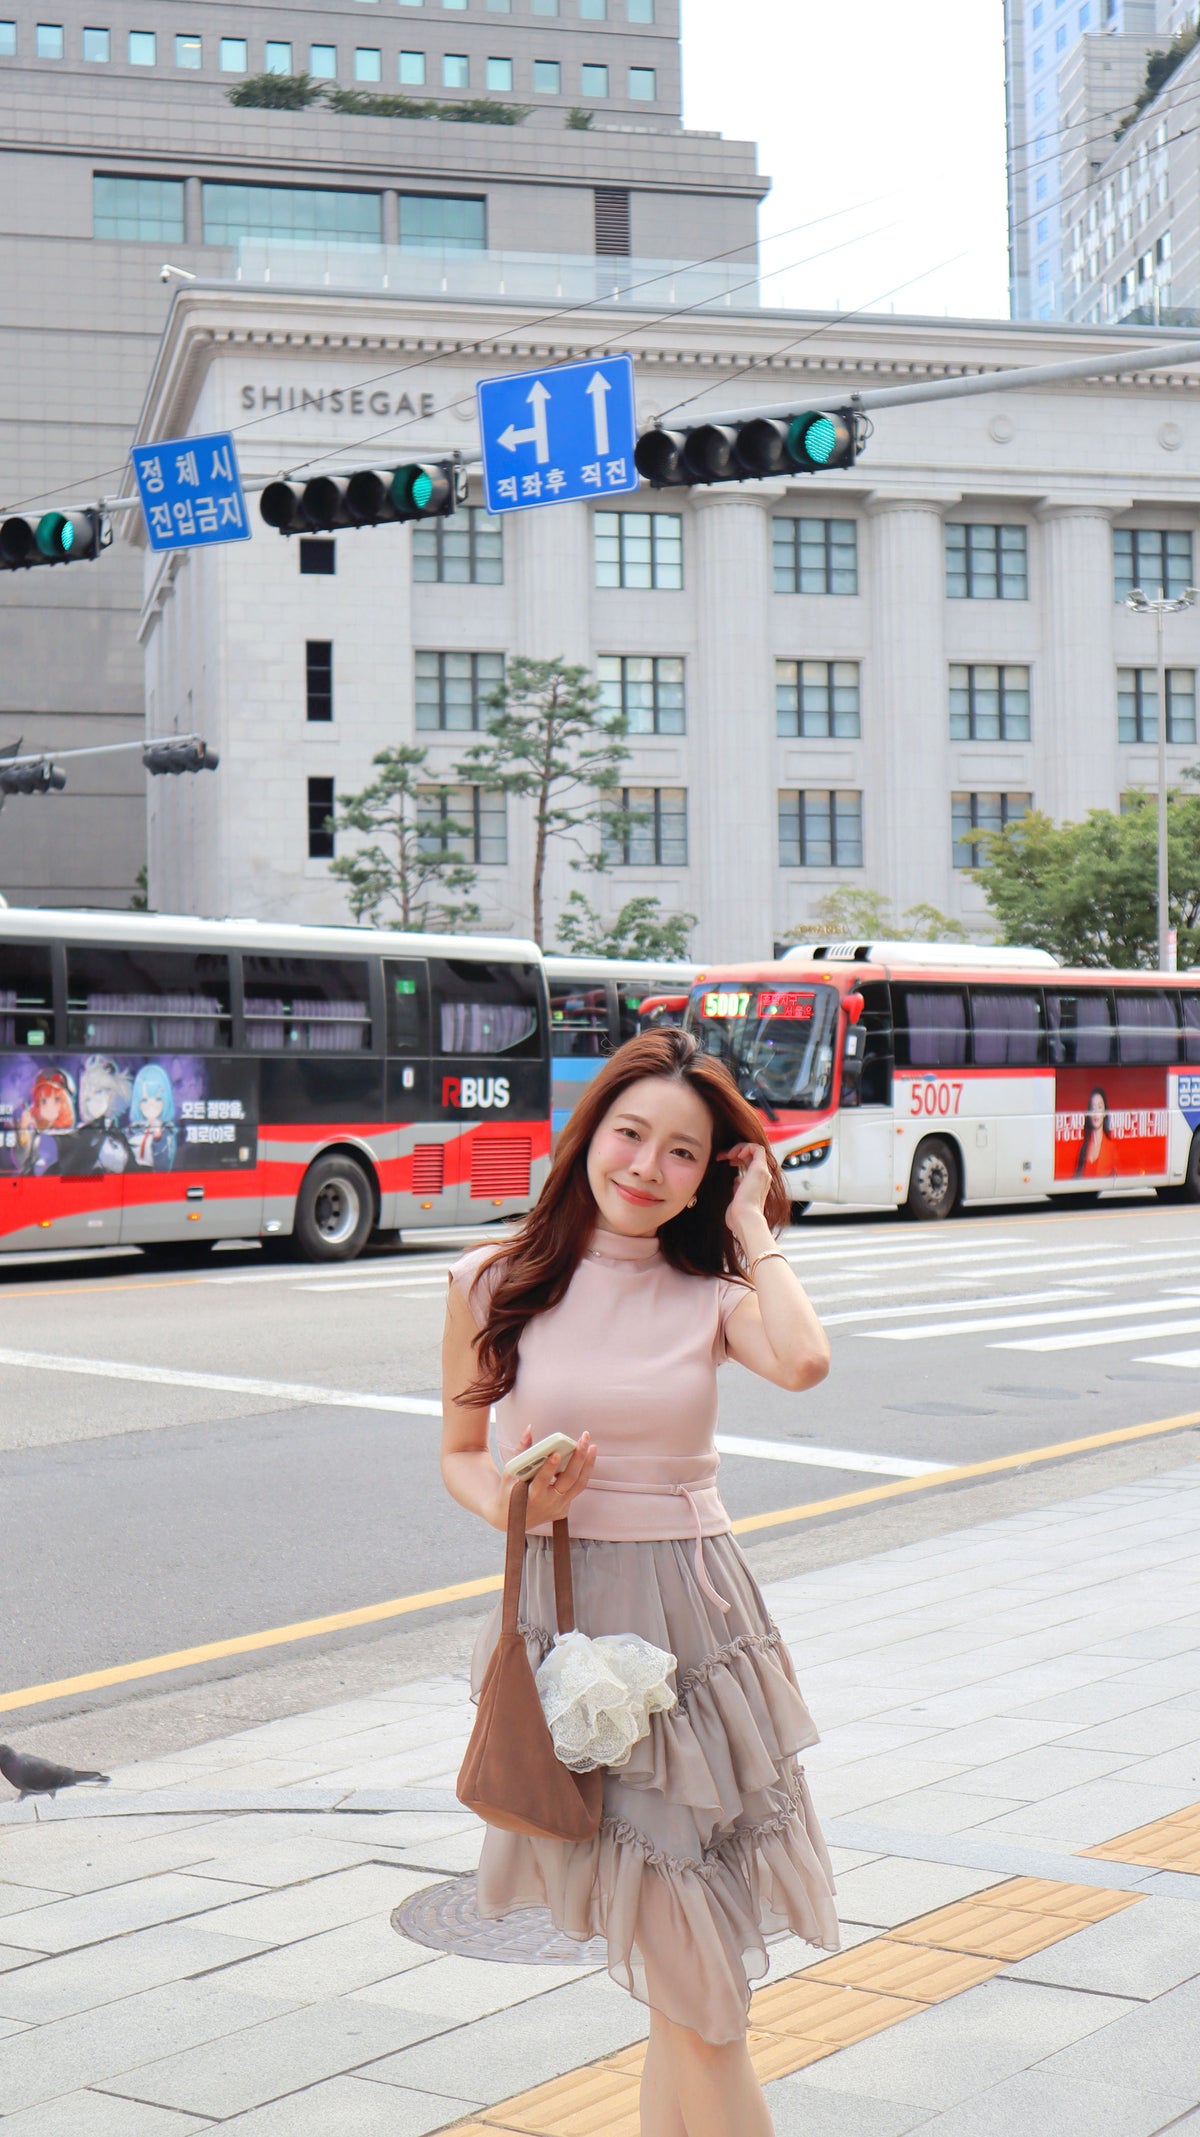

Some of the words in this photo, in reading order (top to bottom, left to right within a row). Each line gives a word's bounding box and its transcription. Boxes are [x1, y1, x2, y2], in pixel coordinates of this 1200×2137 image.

[241, 385, 434, 417] SHINSEGAE
[496, 468, 567, 502] 직좌후
[581, 457, 627, 487] 직진
[149, 492, 242, 539] 진입금지
[705, 993, 750, 1017] 5007
[441, 1076, 510, 1109] RBUS
[910, 1083, 964, 1116] 5007
[180, 1101, 205, 1119] 모든
